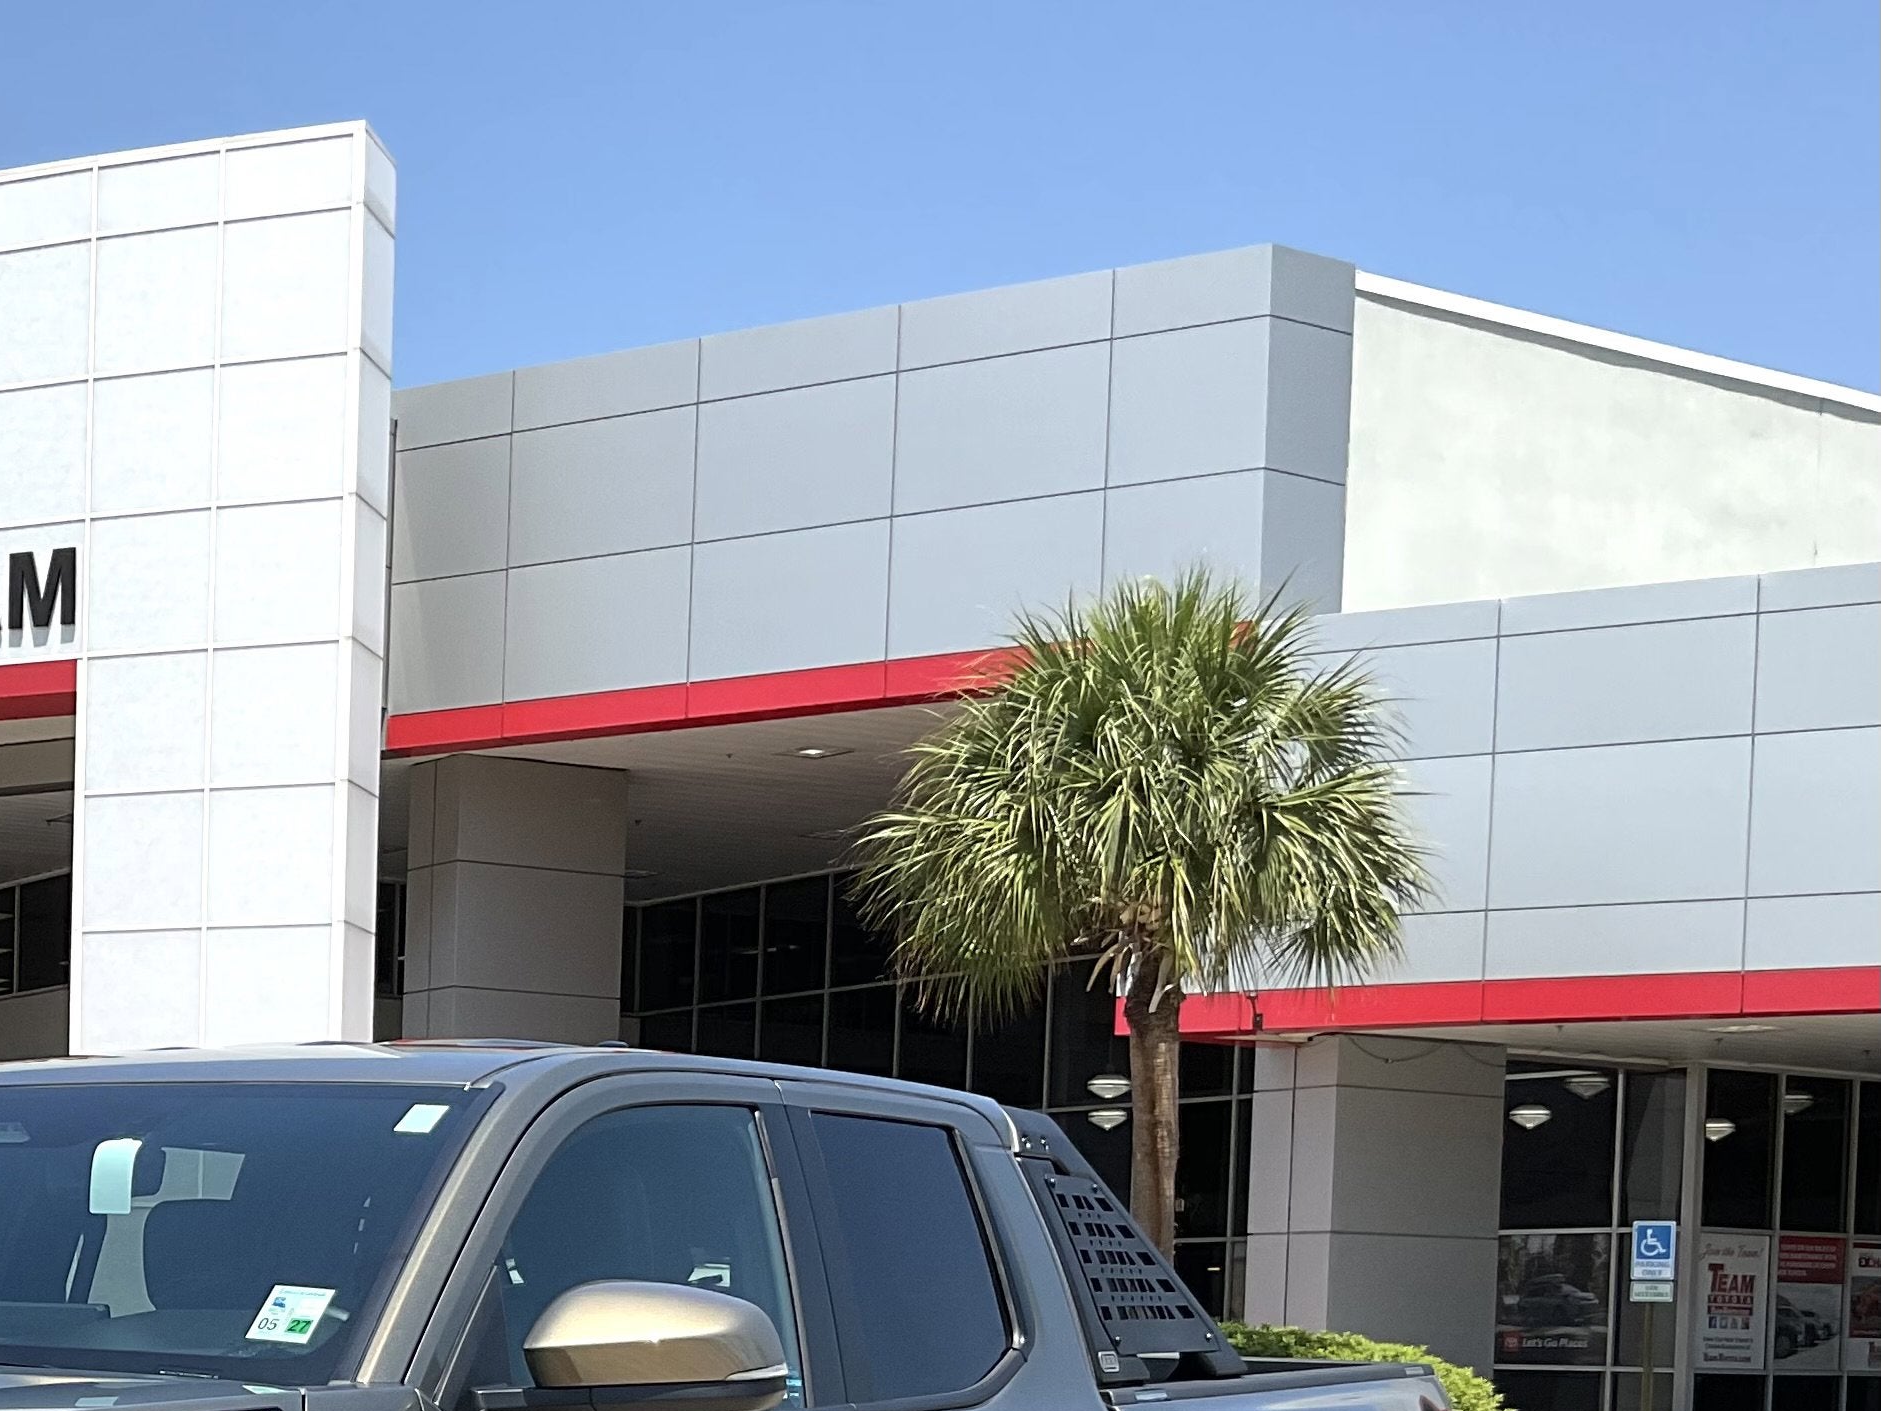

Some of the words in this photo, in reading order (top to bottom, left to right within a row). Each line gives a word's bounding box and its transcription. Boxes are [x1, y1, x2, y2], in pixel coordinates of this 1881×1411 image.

[1709, 1294, 1751, 1305] TOYOTA
[258, 1317, 280, 1330] 05
[287, 1319, 313, 1333] 27
